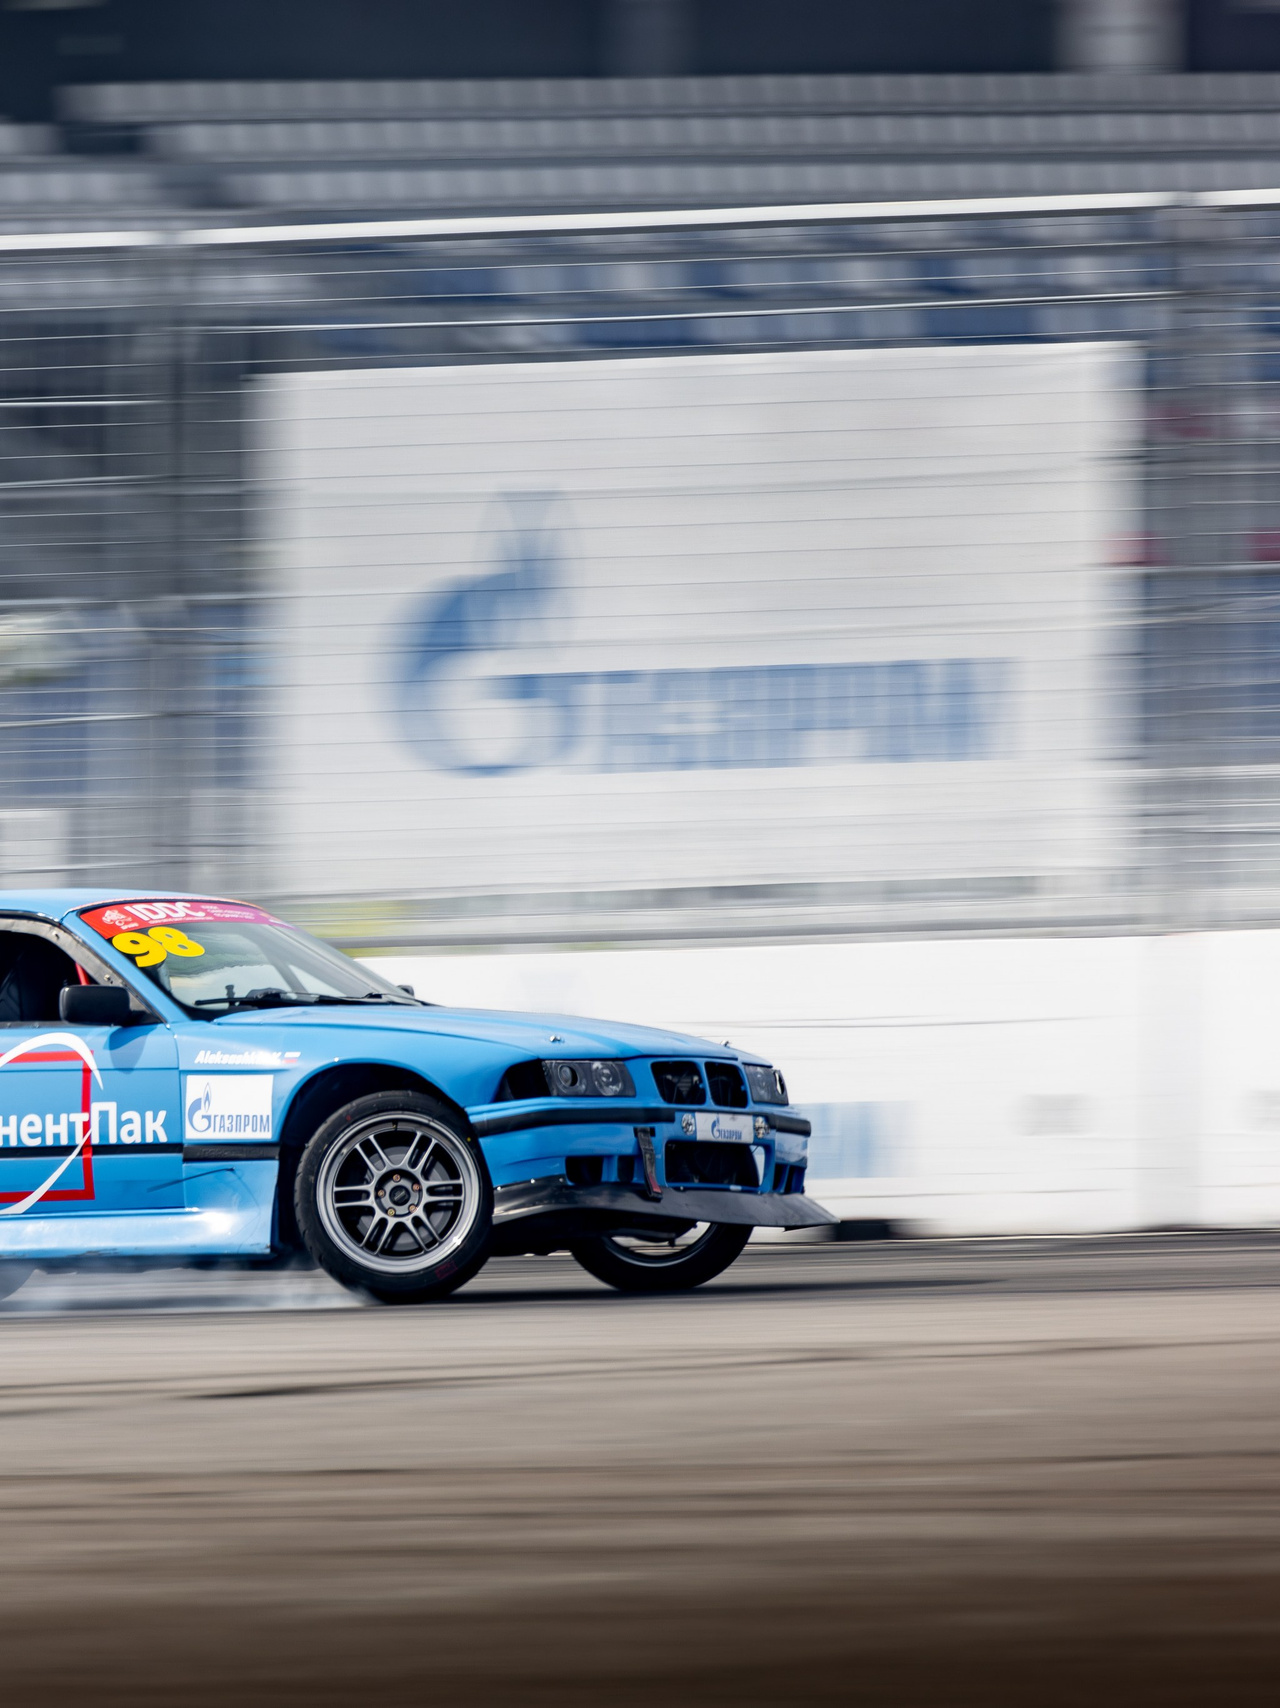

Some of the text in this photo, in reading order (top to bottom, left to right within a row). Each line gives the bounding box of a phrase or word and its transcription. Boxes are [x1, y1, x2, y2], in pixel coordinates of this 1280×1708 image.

[123, 901, 206, 921] IDDC
[112, 926, 205, 968] 98
[212, 1114, 270, 1133] ГАЗПРОМ
